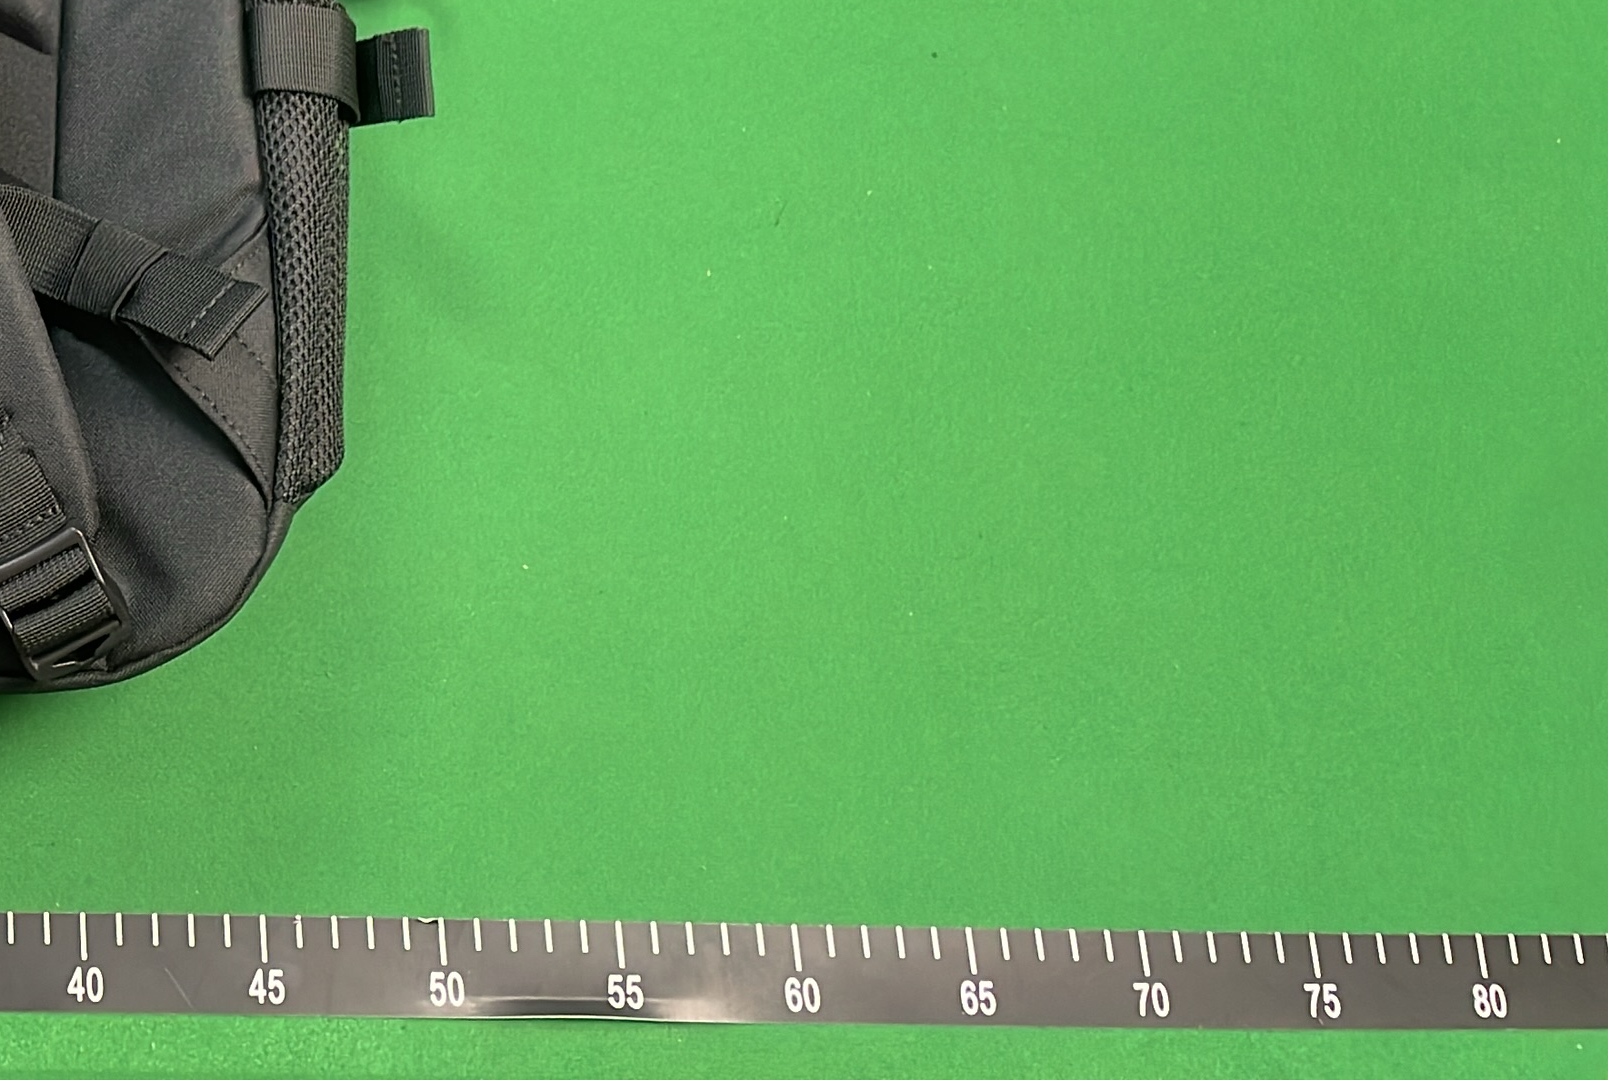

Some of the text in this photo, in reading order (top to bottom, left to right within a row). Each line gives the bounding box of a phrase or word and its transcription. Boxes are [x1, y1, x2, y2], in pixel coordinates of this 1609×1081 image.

[66, 965, 104, 1003] 40
[248, 967, 286, 1005] 45
[429, 971, 465, 1007] 50
[607, 974, 644, 1010] 55
[784, 977, 820, 1013] 60
[959, 979, 997, 1017] 65
[1132, 981, 1170, 1018] 70
[1303, 982, 1342, 1019] 75
[1472, 983, 1508, 1019] 80
